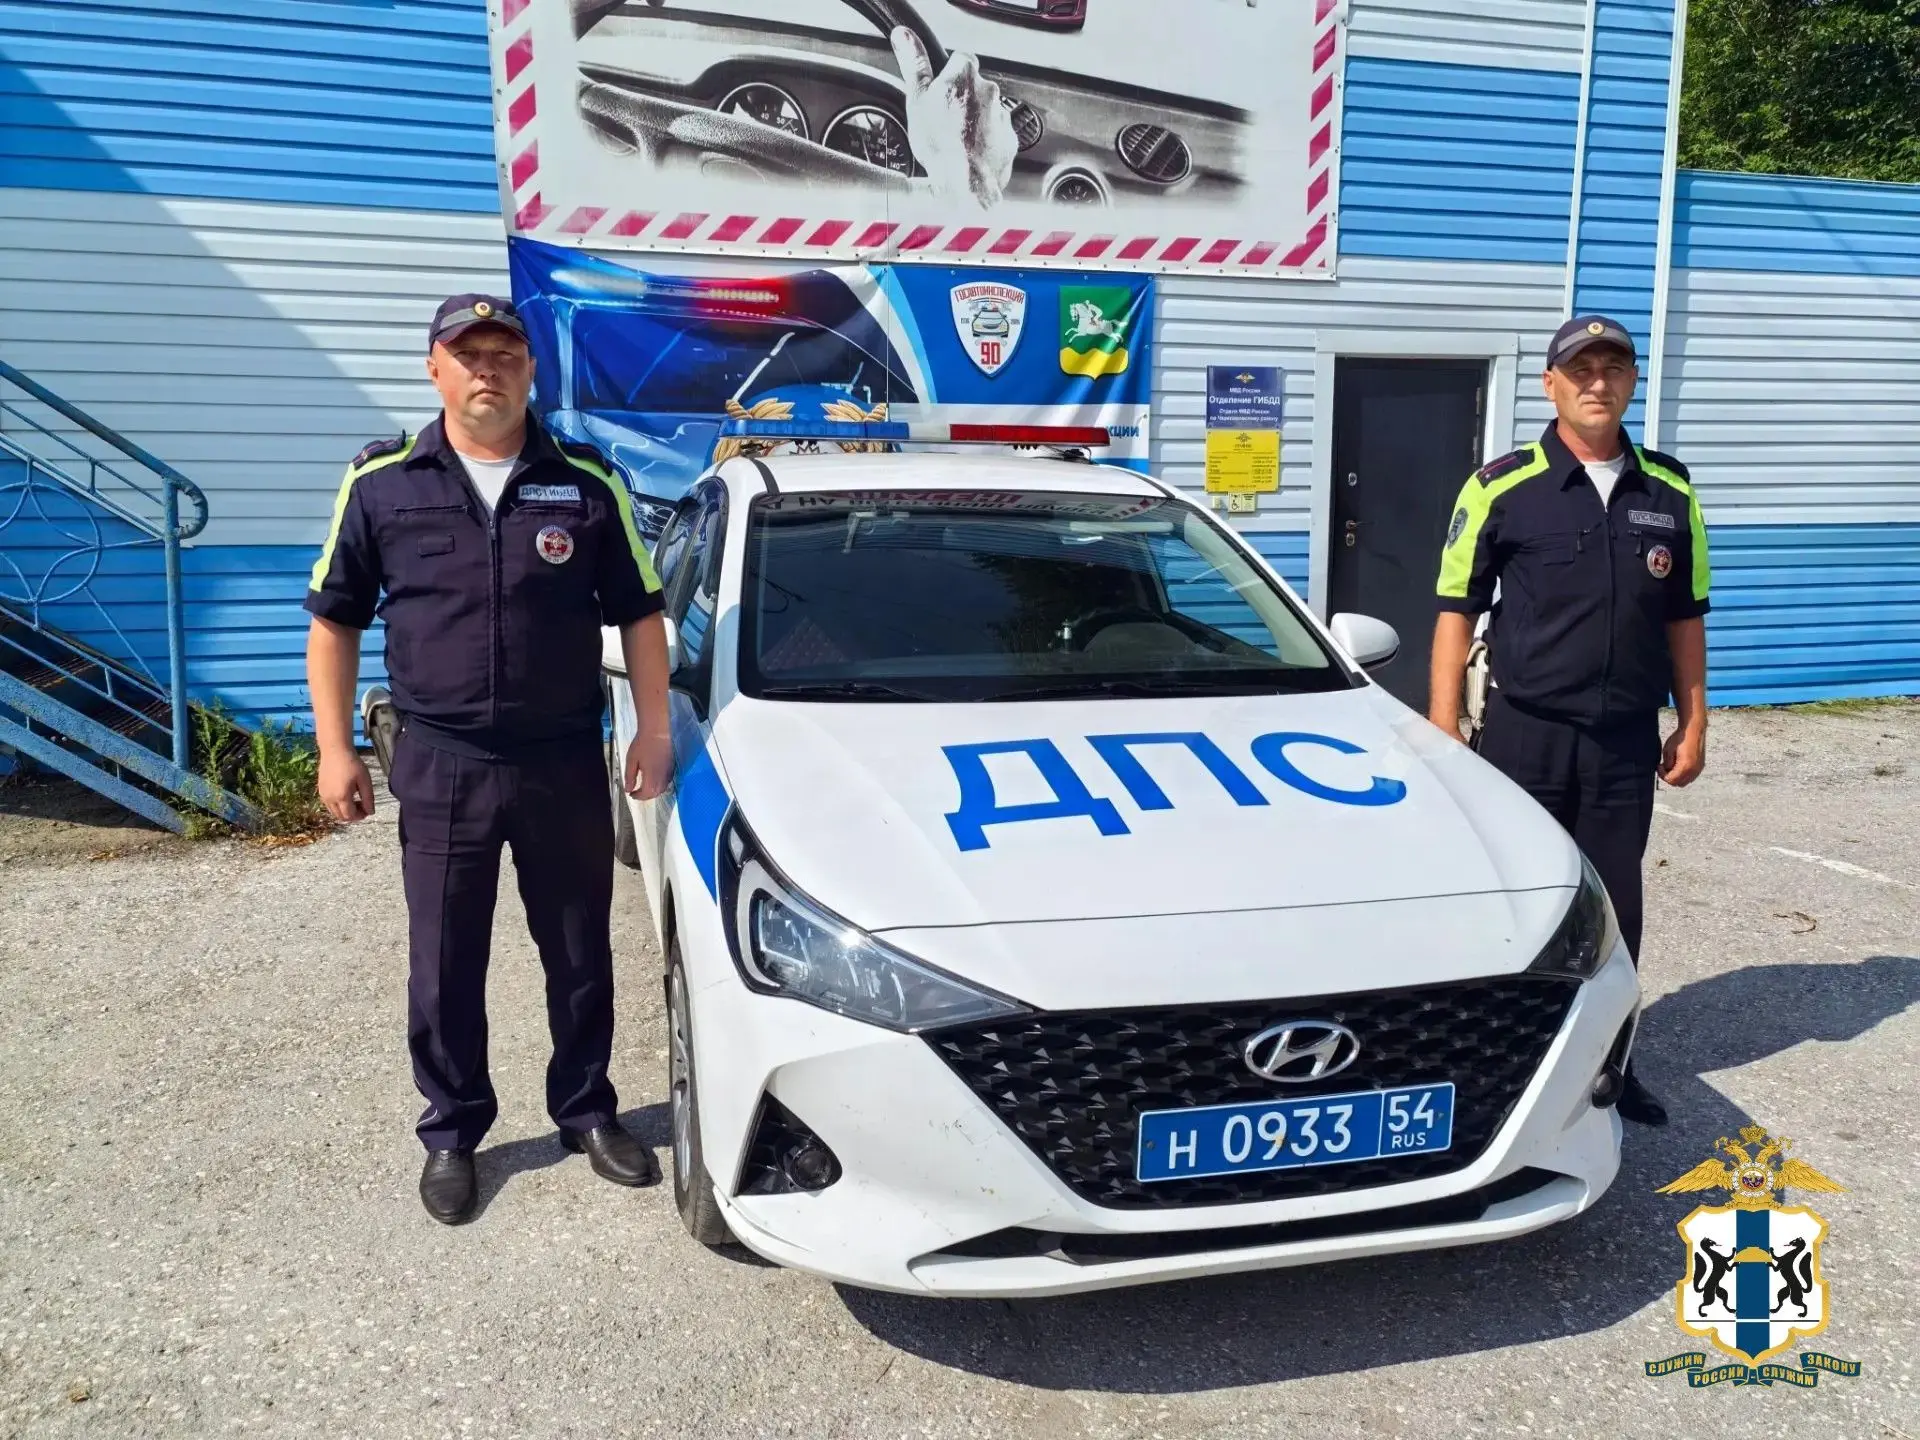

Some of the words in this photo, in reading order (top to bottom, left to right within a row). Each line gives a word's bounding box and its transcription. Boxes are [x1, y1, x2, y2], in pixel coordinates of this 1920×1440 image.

[955, 286, 1025, 304] ГОСАВТОИНСПЕКЦИЯ
[981, 341, 1000, 365] 90
[1209, 396, 1251, 404] Отделение
[1253, 396, 1280, 405] ГИБДД
[940, 732, 1407, 852] ДПС
[1168, 1130, 1197, 1170] Н
[1222, 1104, 1353, 1164] 0933
[1388, 1092, 1434, 1132] 54
[1392, 1132, 1426, 1149] RUS
